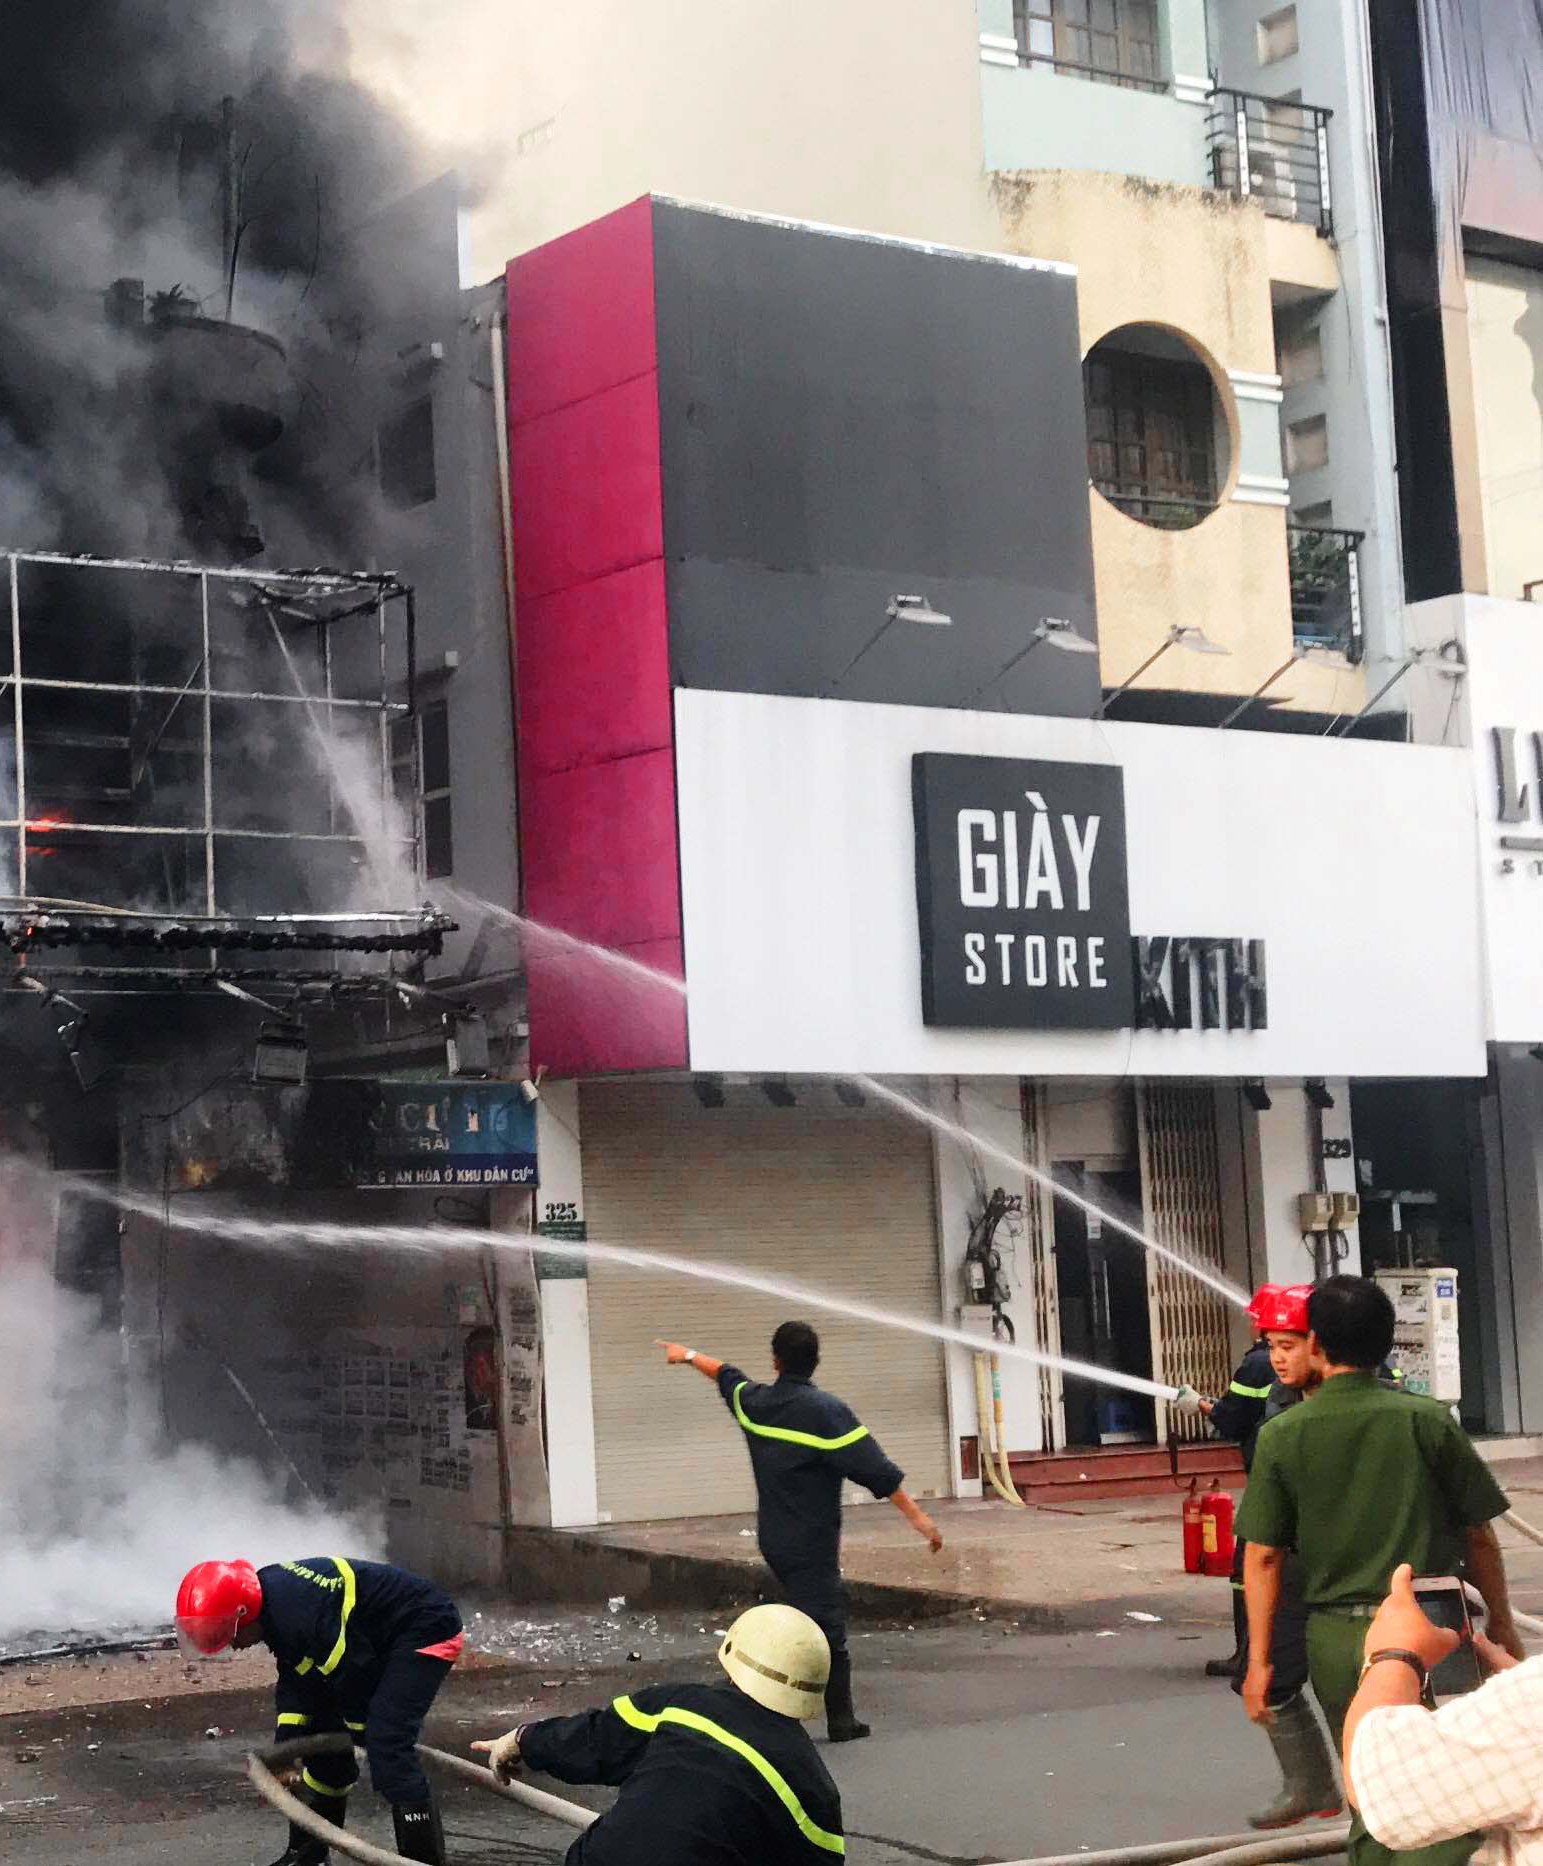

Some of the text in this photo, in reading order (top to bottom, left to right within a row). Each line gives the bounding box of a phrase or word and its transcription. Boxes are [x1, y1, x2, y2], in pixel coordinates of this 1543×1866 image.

[958, 791, 1100, 911] GIÀY
[964, 933, 1106, 988] STORE
[1131, 935, 1267, 1030] KITH
[457, 1168, 482, 1182] KHU
[545, 1202, 578, 1220] 325
